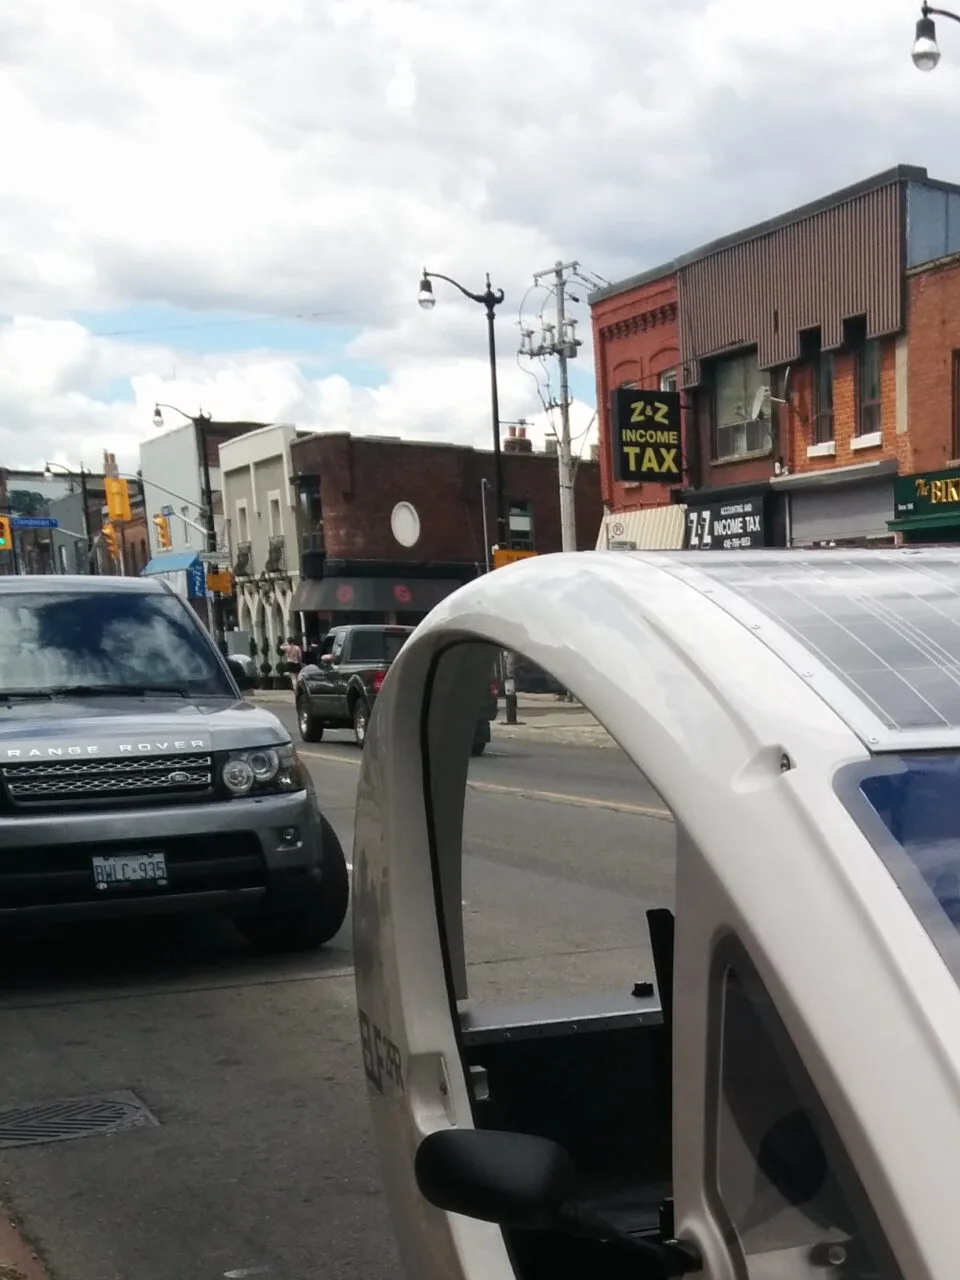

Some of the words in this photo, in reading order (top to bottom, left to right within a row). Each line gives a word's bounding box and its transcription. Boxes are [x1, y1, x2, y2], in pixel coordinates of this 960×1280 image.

[630, 400, 670, 425] Z&Z
[622, 429, 679, 444] INCOME
[623, 446, 679, 473] TAX
[713, 517, 744, 536] INCOME
[744, 514, 761, 533] TAX
[7, 746, 99, 758] RANGE
[119, 740, 204, 752] ROVER
